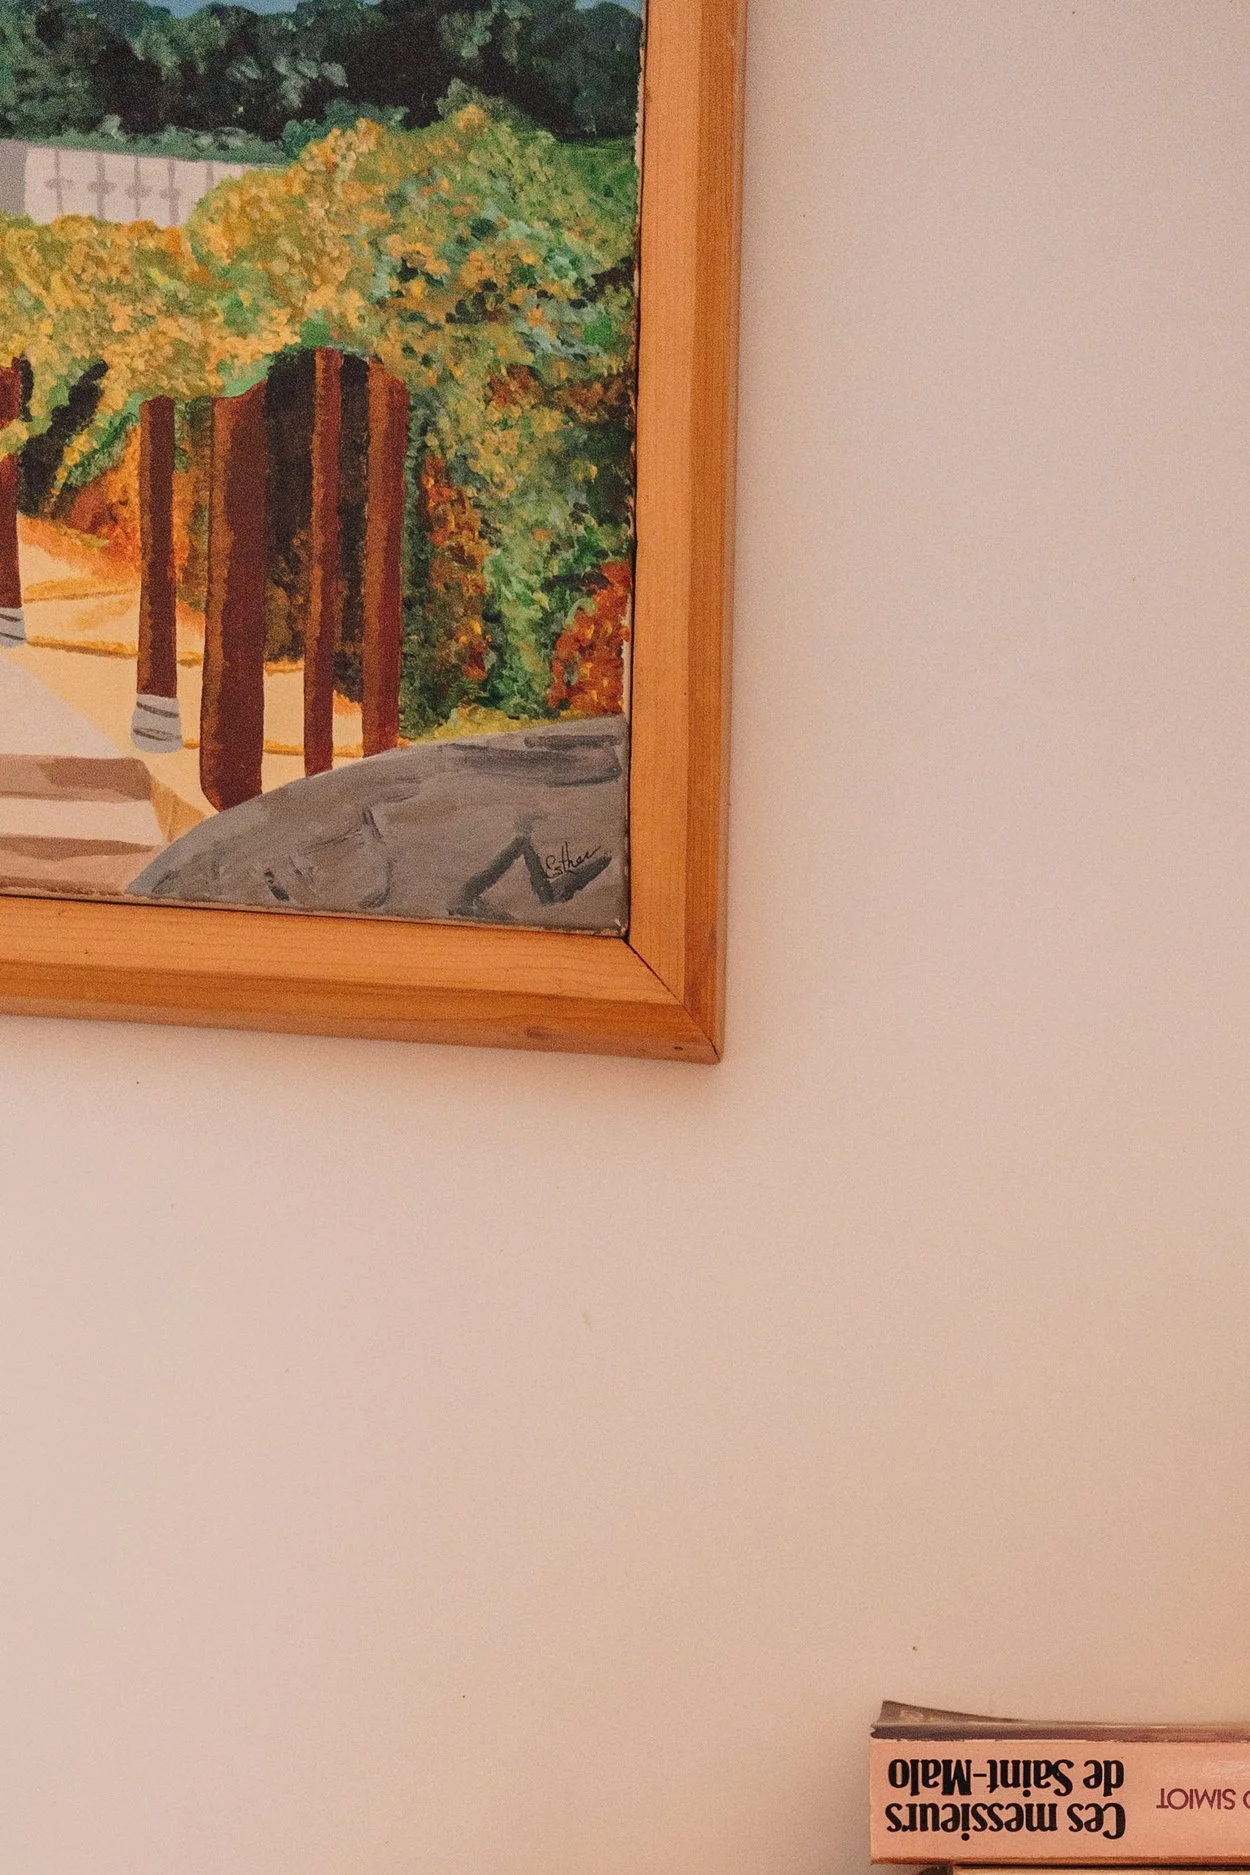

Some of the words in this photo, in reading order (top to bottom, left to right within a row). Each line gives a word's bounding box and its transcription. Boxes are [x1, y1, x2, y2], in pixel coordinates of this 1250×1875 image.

[888, 1758, 1075, 1797] Saint-Malo
[1083, 1759, 1125, 1796] de
[1156, 1787, 1236, 1811] SIMIOT
[885, 1802, 1057, 1841] messieurs
[1068, 1803, 1126, 1840] Ces
